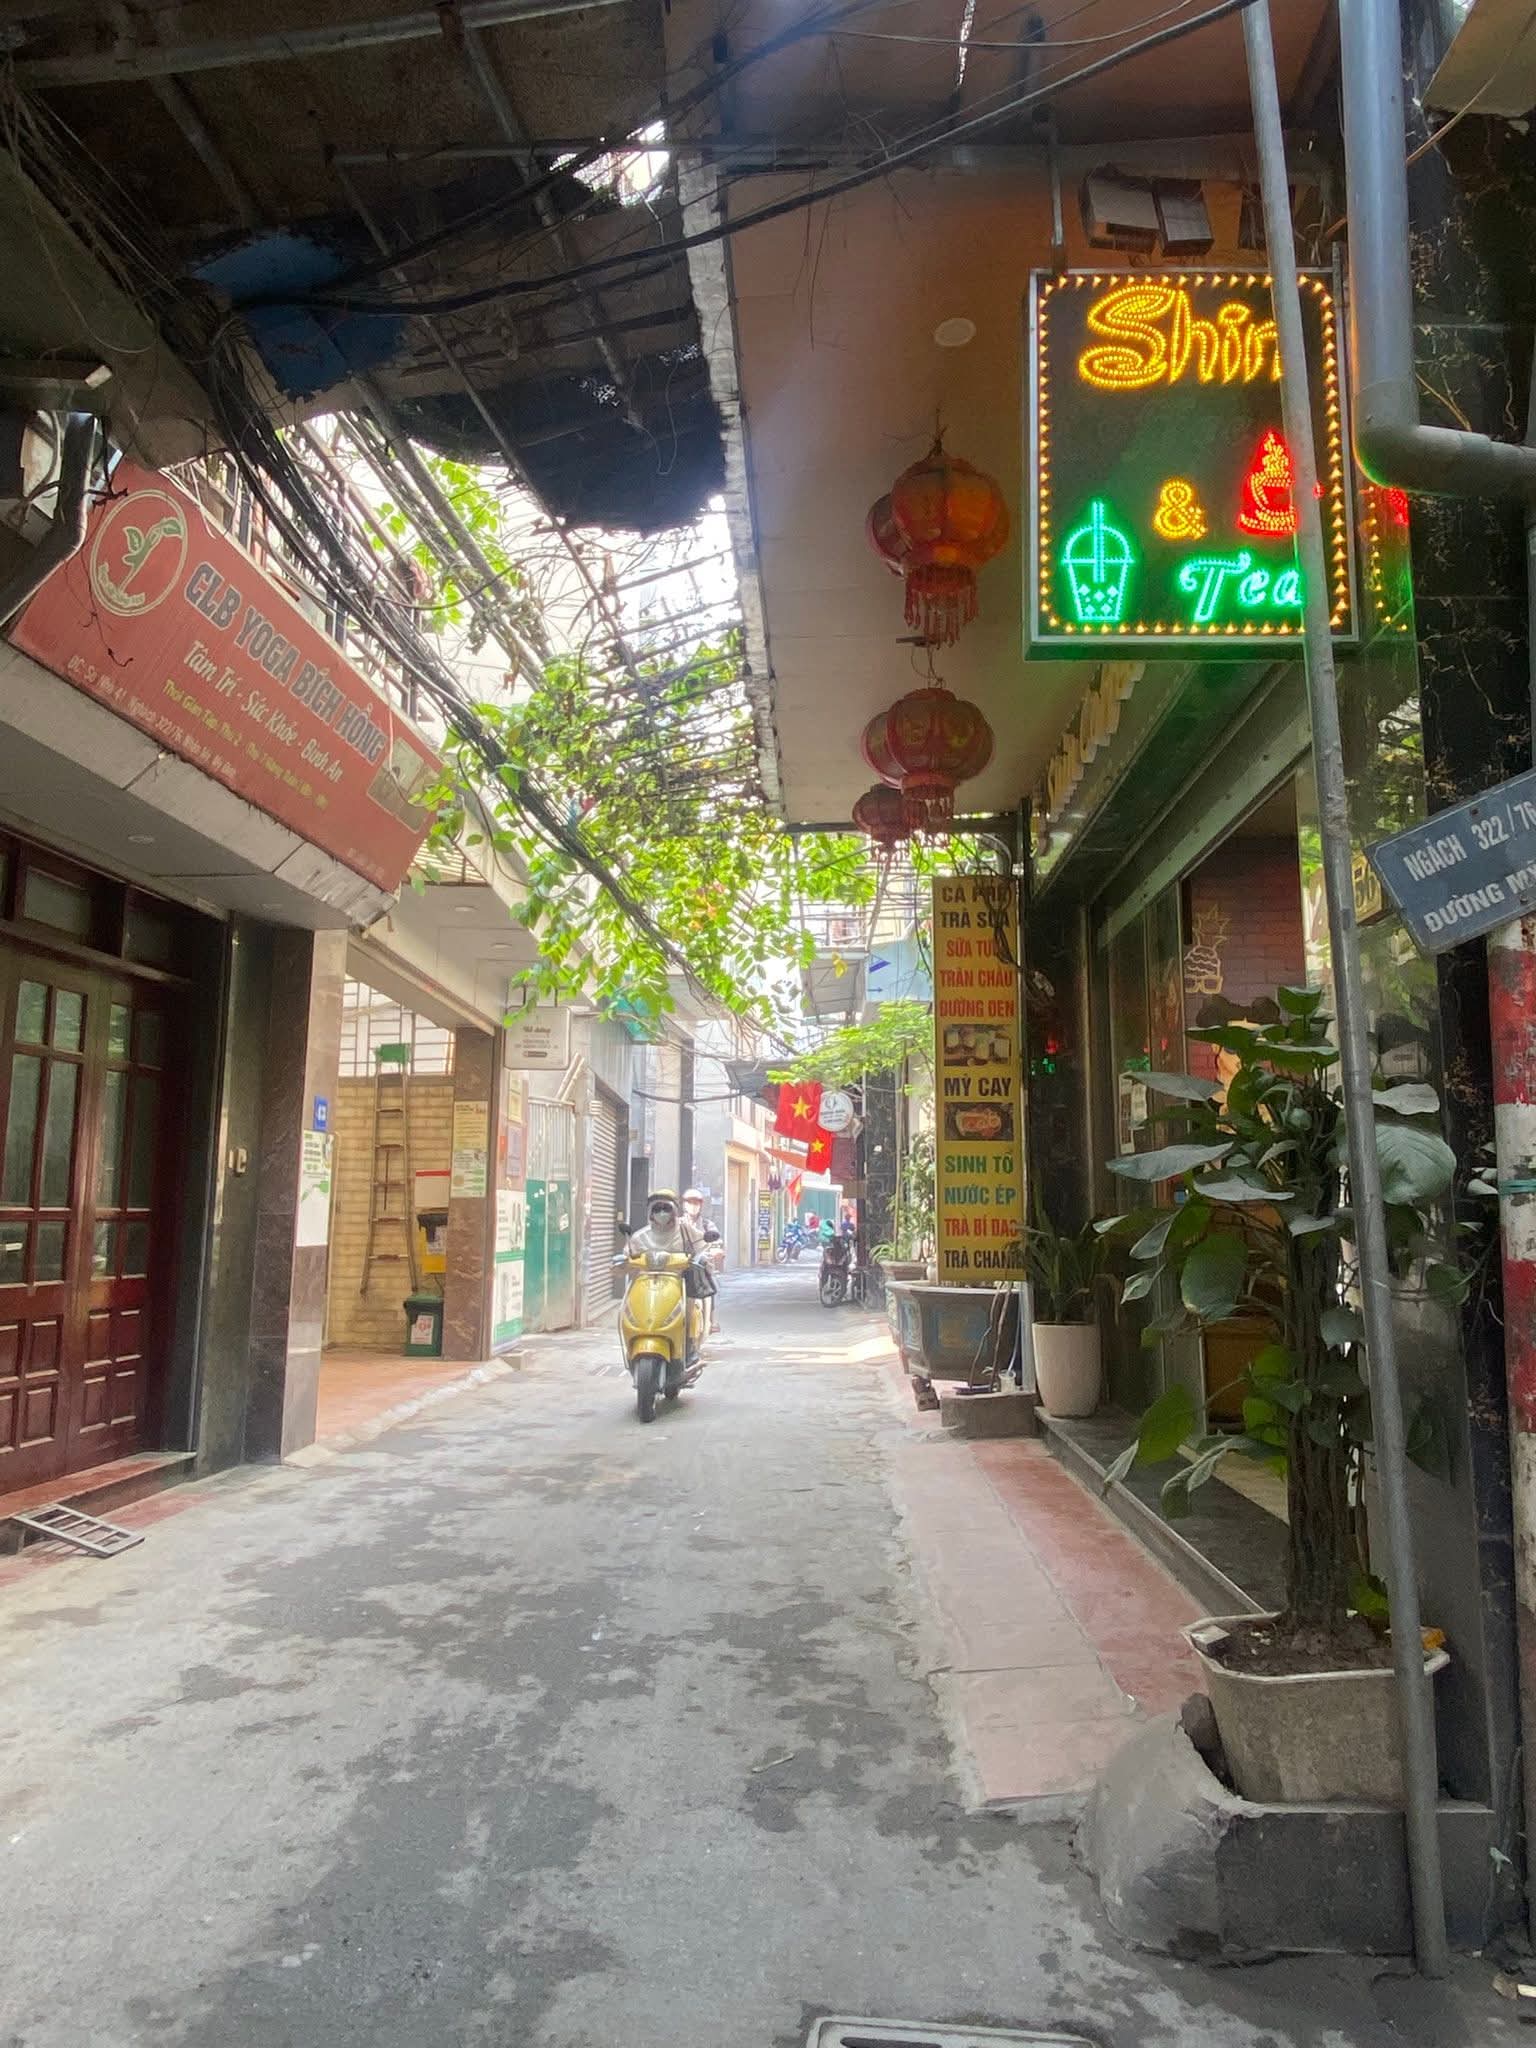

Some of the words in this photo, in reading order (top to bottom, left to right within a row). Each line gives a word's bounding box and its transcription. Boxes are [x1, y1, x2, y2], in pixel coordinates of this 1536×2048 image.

[1079, 284, 1283, 388] Shin
[1153, 480, 1207, 539] &
[1178, 551, 1303, 622] Tea
[184, 561, 242, 631] CLB
[234, 605, 300, 687] YOGA
[289, 660, 346, 725] BÍCH
[333, 702, 388, 766] HỒNG
[184, 640, 217, 682] Tâm
[215, 666, 243, 697] Trí
[241, 690, 270, 724] Sức
[1403, 834, 1467, 881] NGÁCH
[940, 907, 971, 928] TRÀ
[1423, 883, 1505, 933] ĐƯỜNG
[978, 1077, 1012, 1097] CAY
[945, 1155, 987, 1173] SINH
[944, 1184, 990, 1205] NƯỚC
[996, 1184, 1016, 1205] ÉP
[944, 1213, 969, 1236] TRÀ
[974, 1214, 987, 1236] BÍ
[944, 1246, 969, 1268] TRÀ
